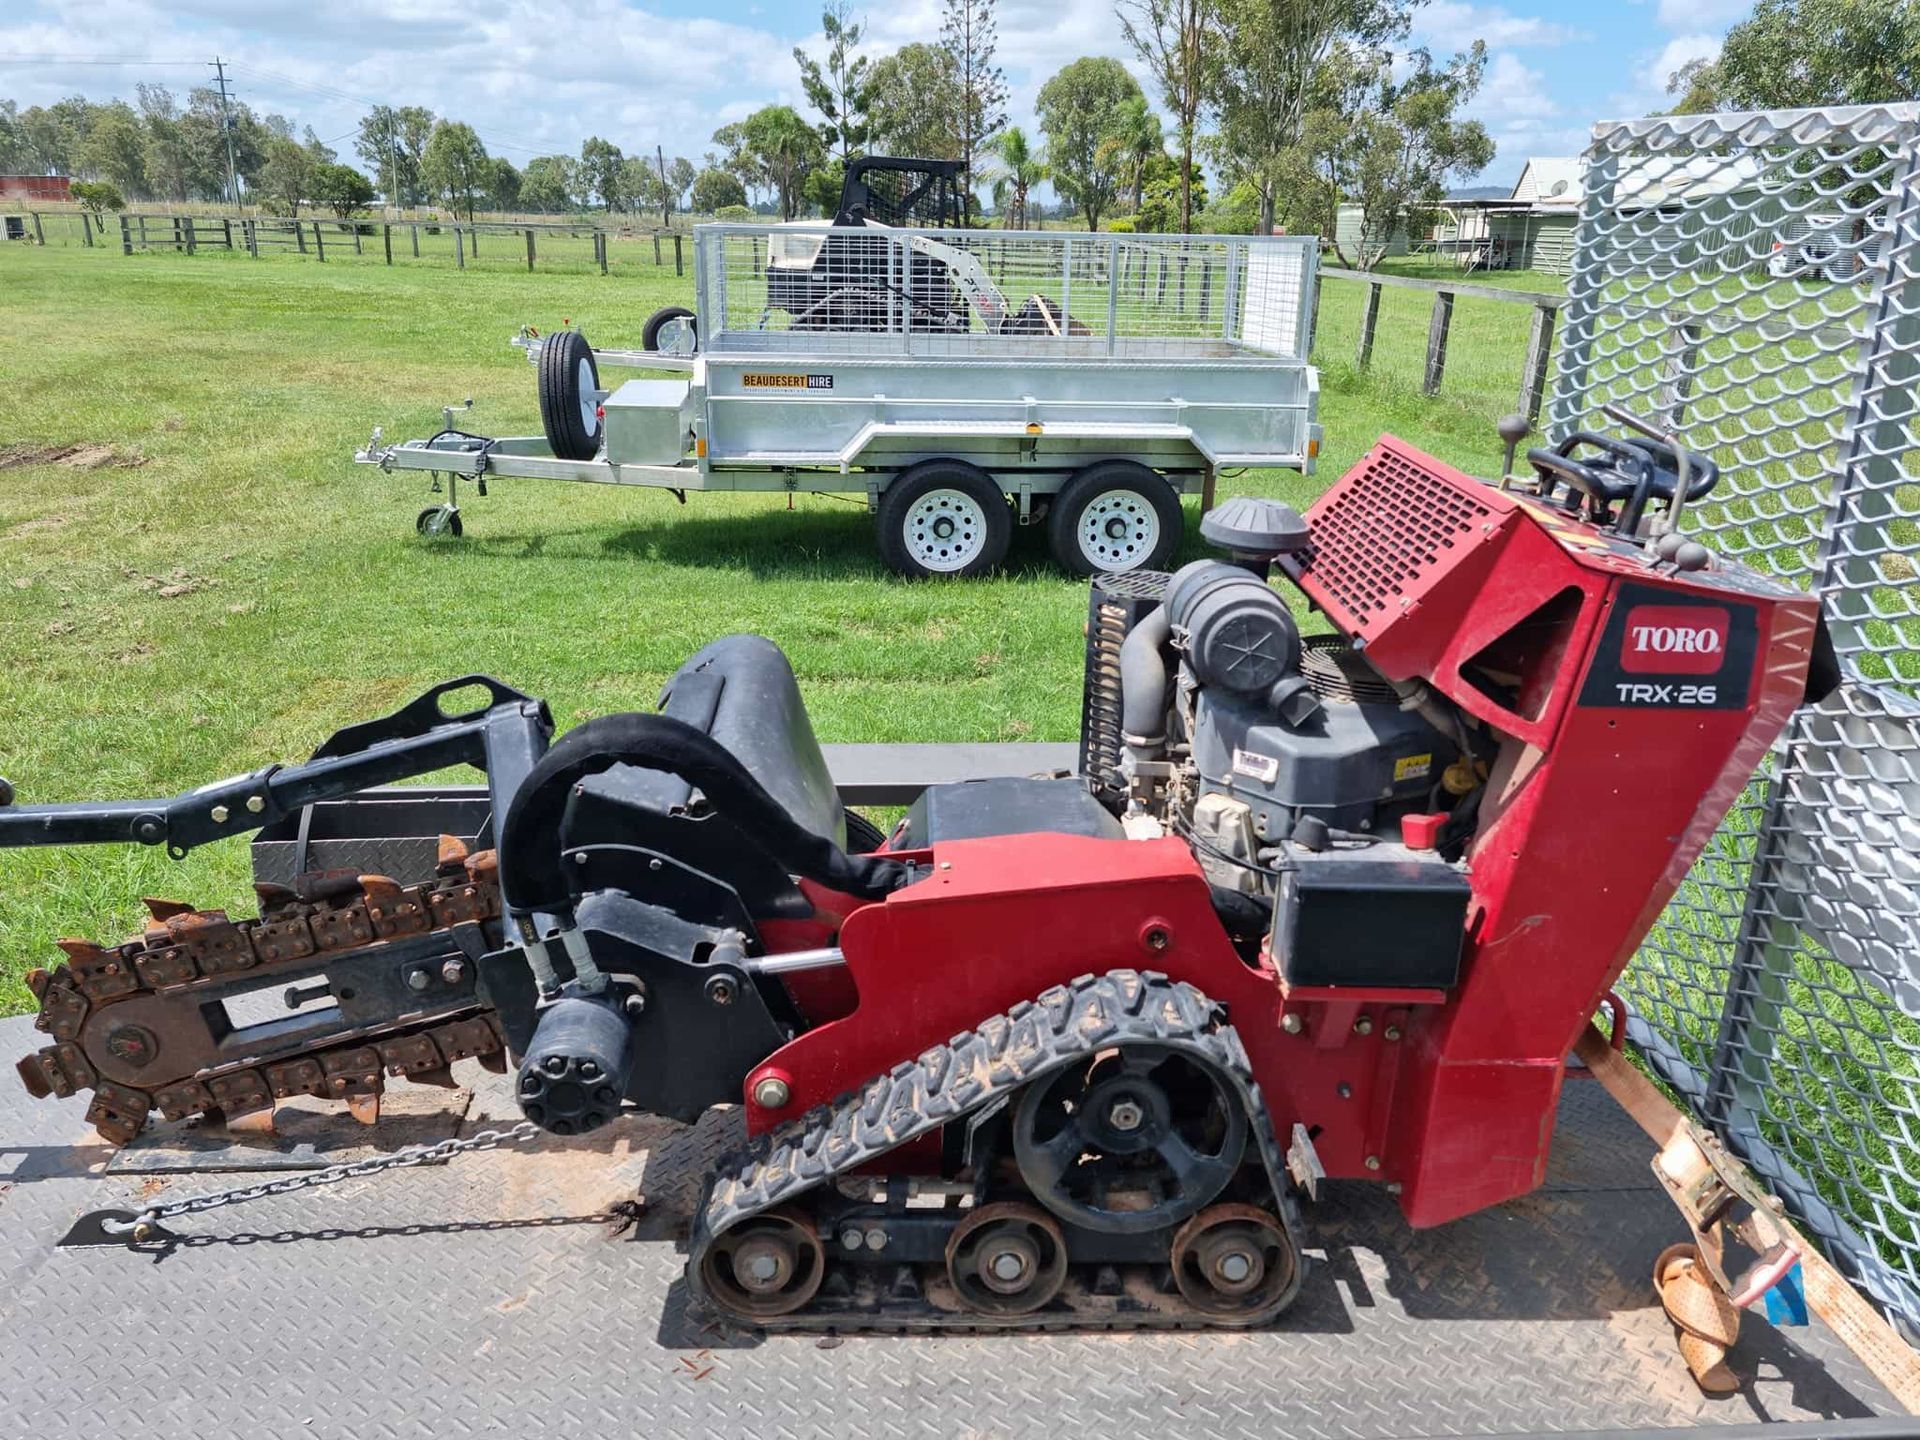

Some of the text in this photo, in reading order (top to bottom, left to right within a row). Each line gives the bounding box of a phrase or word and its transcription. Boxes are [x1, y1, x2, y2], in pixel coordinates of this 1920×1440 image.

[744, 375, 832, 388] BEAUDESERT HIRE
[1632, 626, 1719, 653] TORO
